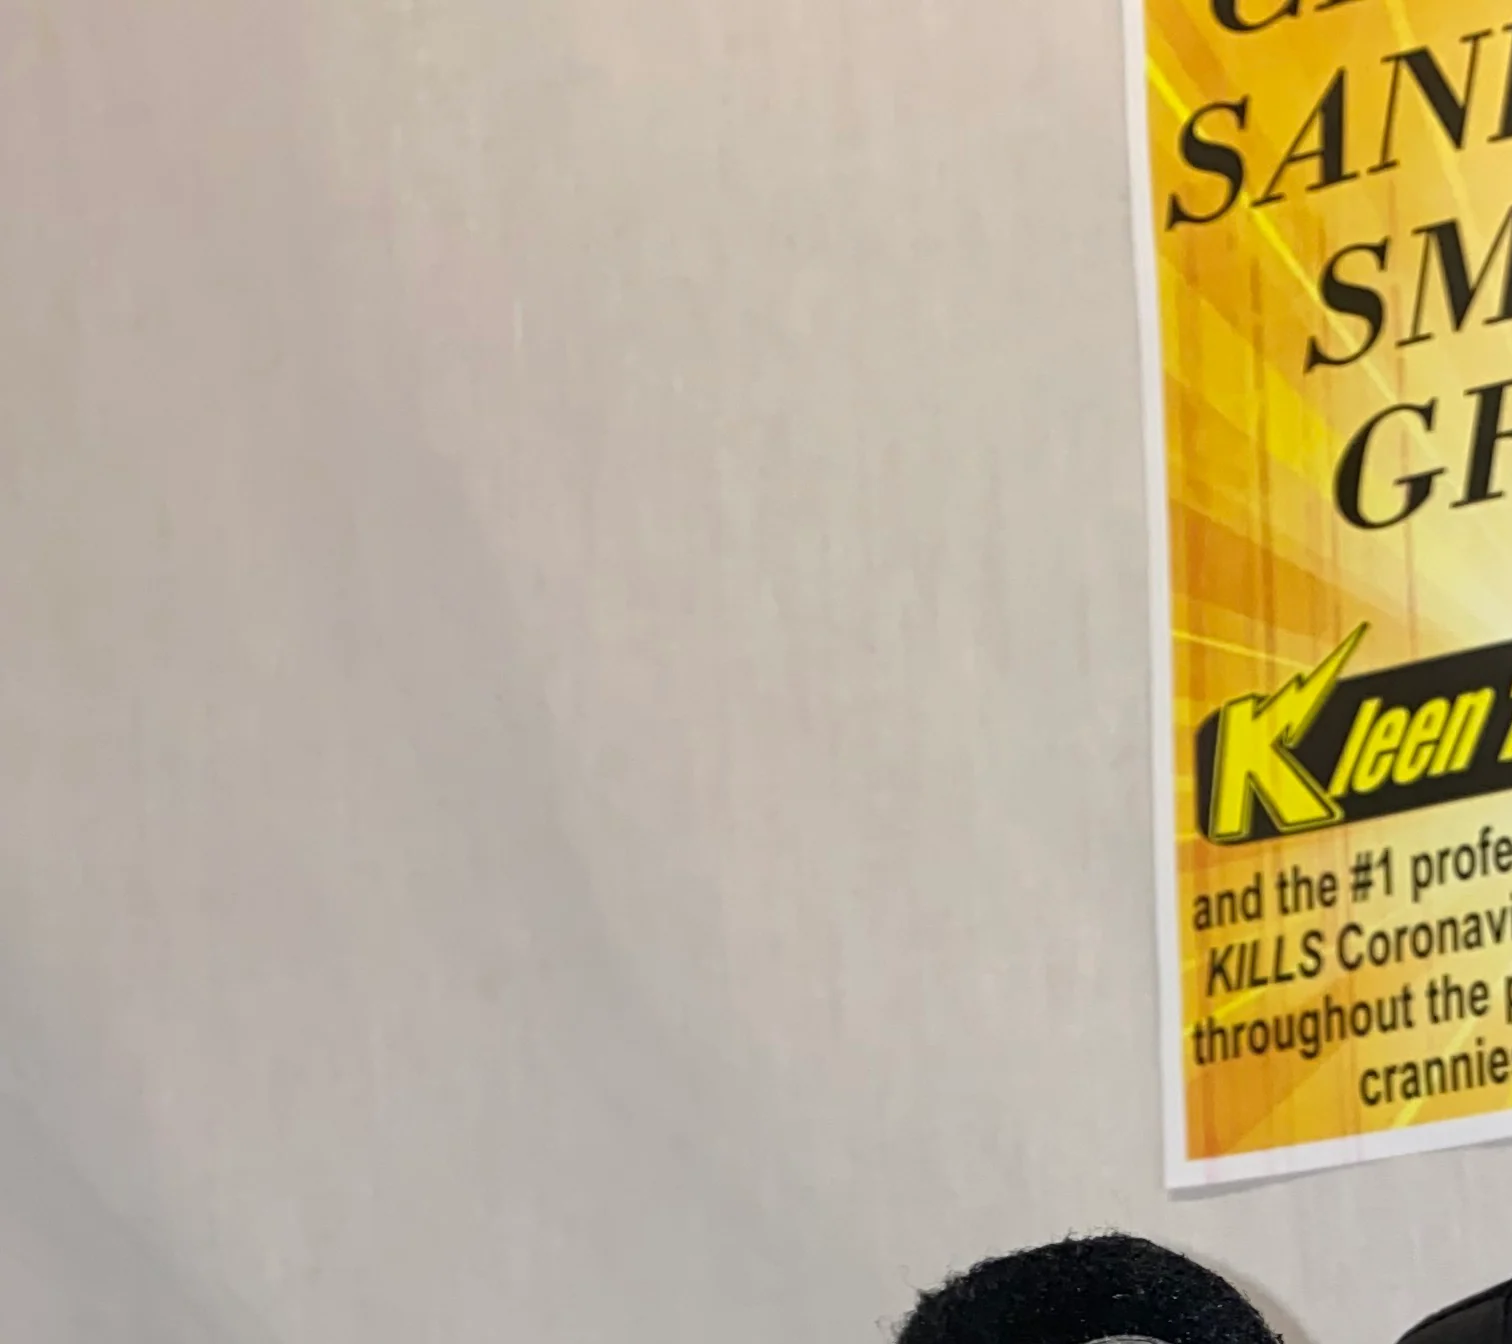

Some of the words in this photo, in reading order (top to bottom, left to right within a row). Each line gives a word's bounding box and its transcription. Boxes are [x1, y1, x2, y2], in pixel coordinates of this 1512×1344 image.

[1208, 621, 1496, 839] Kleen
[1193, 873, 1263, 931] and
[1275, 866, 1338, 916] the
[1351, 848, 1393, 901] #1
[1205, 930, 1325, 998] KILLS
[1193, 982, 1416, 1066] throughout
[1426, 973, 1490, 1025] the
